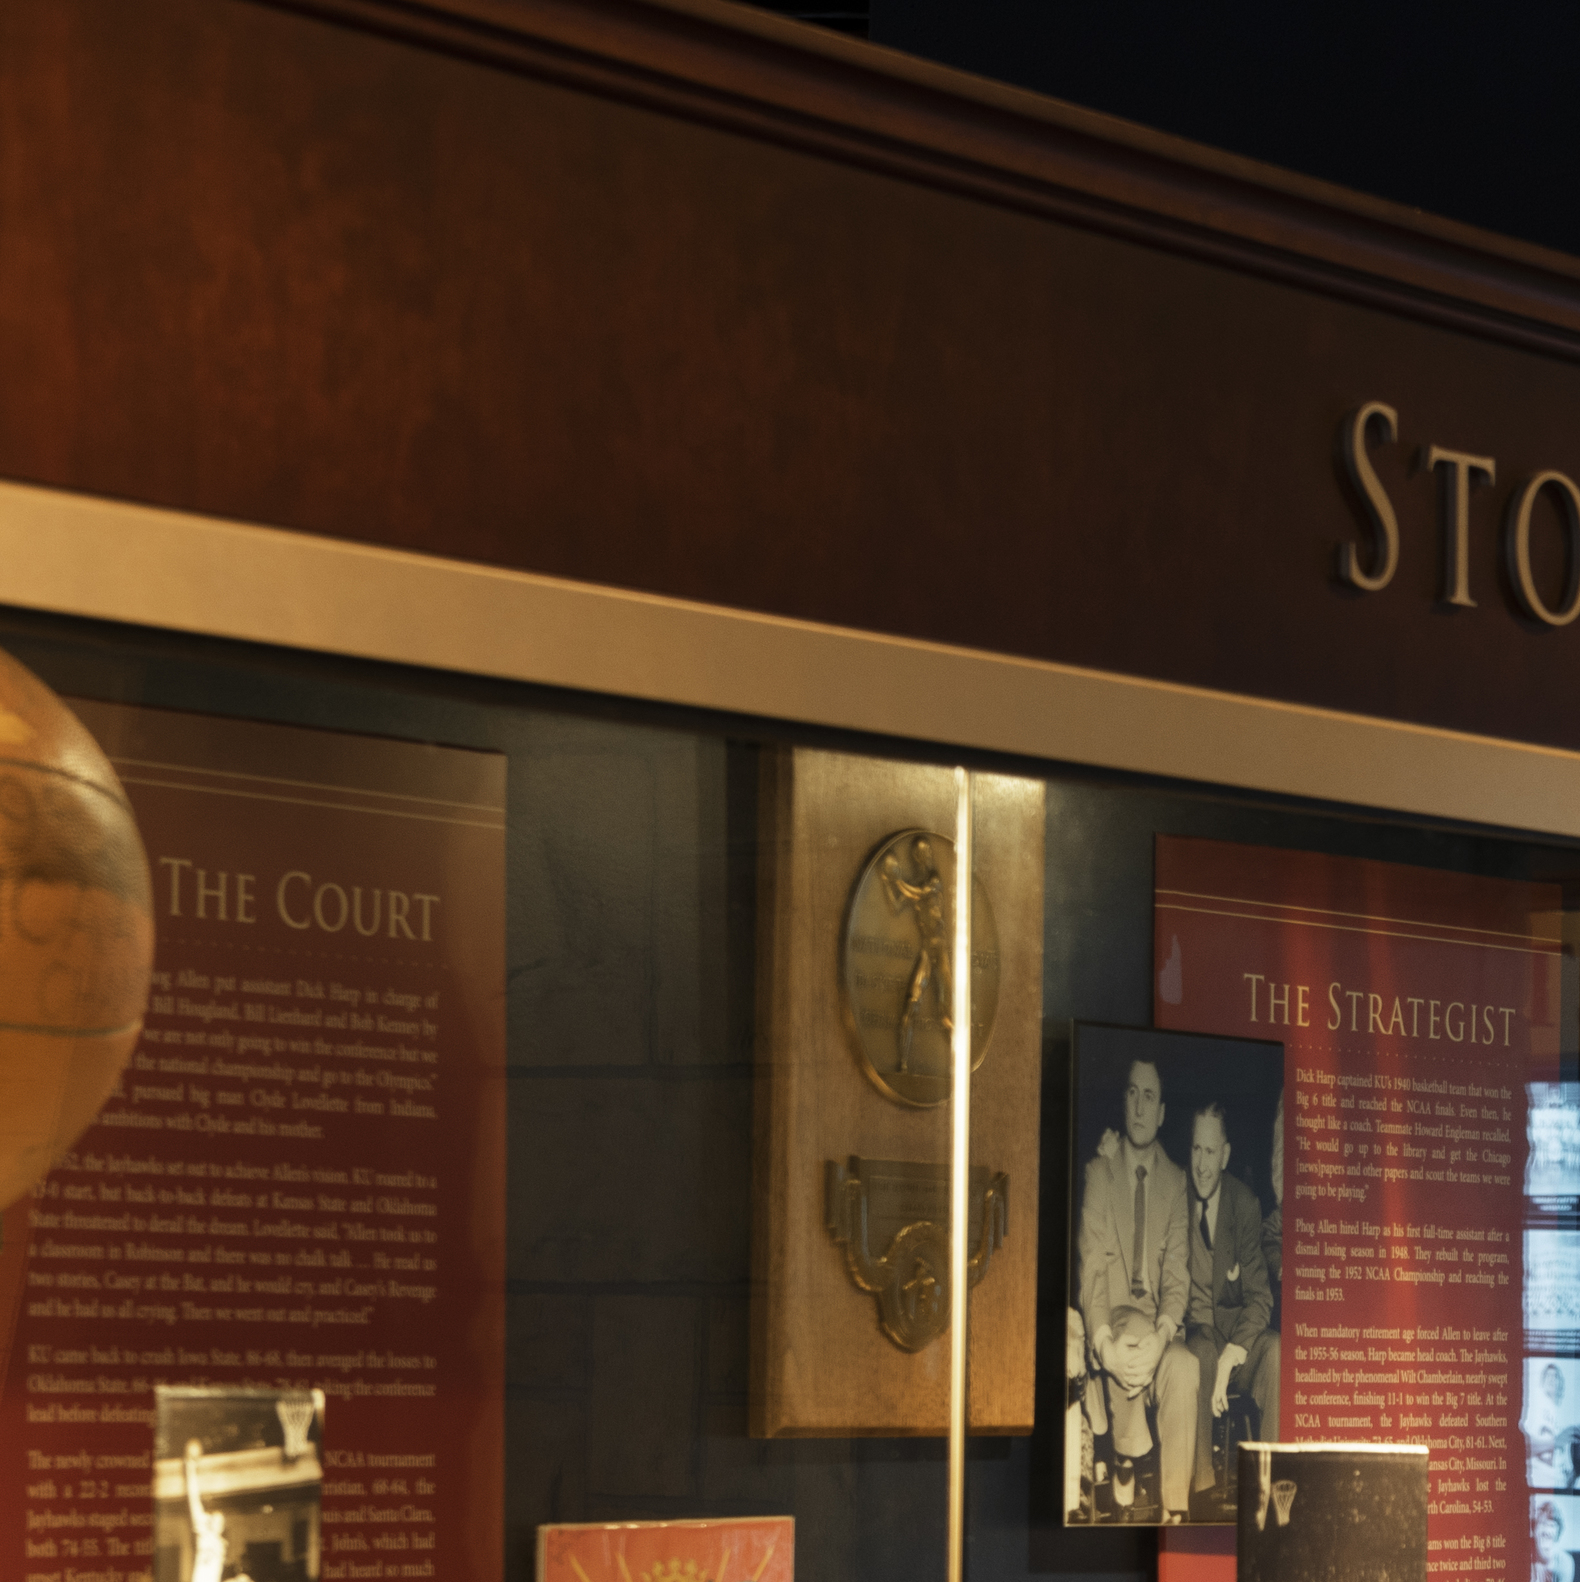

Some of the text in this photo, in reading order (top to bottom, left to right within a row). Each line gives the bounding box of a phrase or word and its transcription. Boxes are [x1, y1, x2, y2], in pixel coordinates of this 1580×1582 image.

[159, 856, 441, 942] THE COURT
[1243, 972, 1516, 1047] THE STRATEGIST
[1296, 1068, 1511, 1099] Dick Harp captained KU's 1940 basketball team that won the
[1296, 1090, 1511, 1121] Big 6 title and reached the NCAA finals. Even then, he
[1295, 1390, 1507, 1409] the conference, finishing 11-1 to win the Big 7 title. At the
[1295, 1413, 1507, 1430] NCAA tournament, the Jayhawks defeated Southern
[1448, 1456, 1506, 1473] City, Missouri. In
